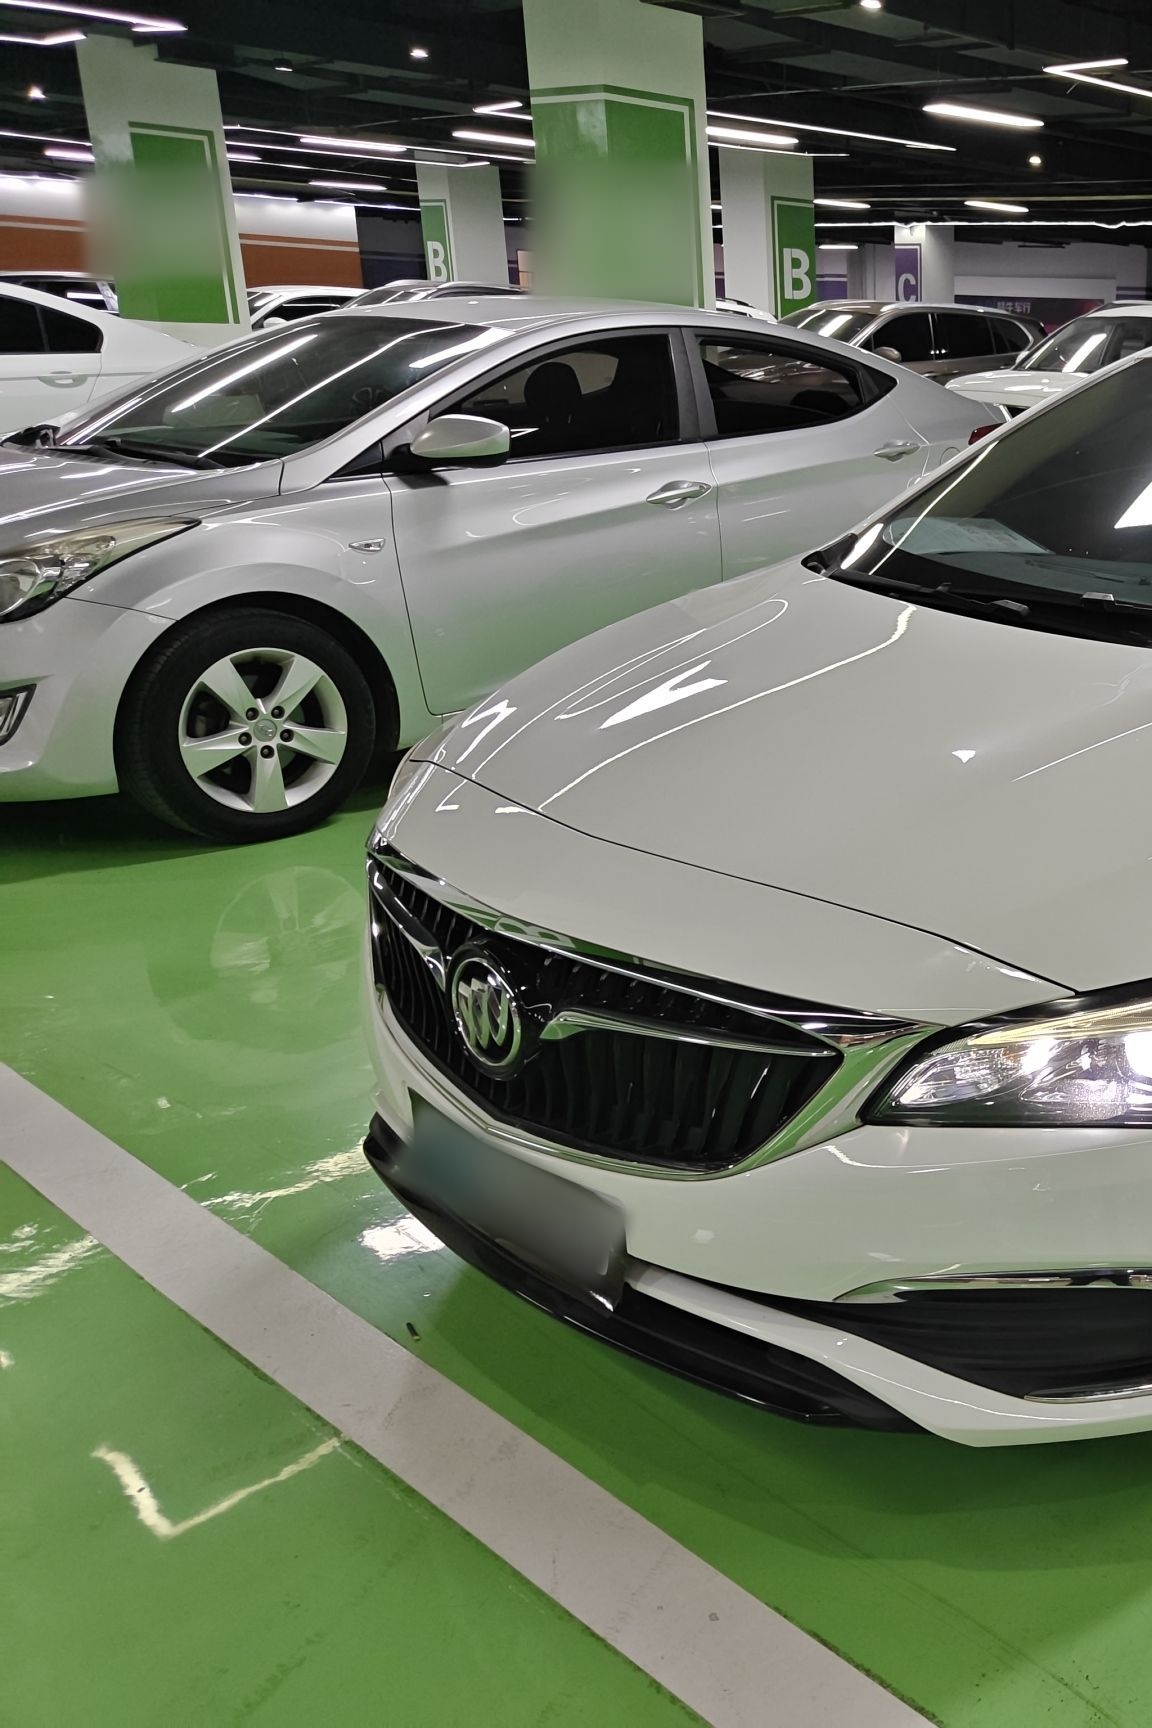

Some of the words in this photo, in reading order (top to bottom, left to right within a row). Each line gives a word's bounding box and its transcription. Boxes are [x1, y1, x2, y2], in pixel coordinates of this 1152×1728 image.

[427, 241, 448, 281] B
[782, 247, 812, 300] B
[898, 273, 916, 302] C
